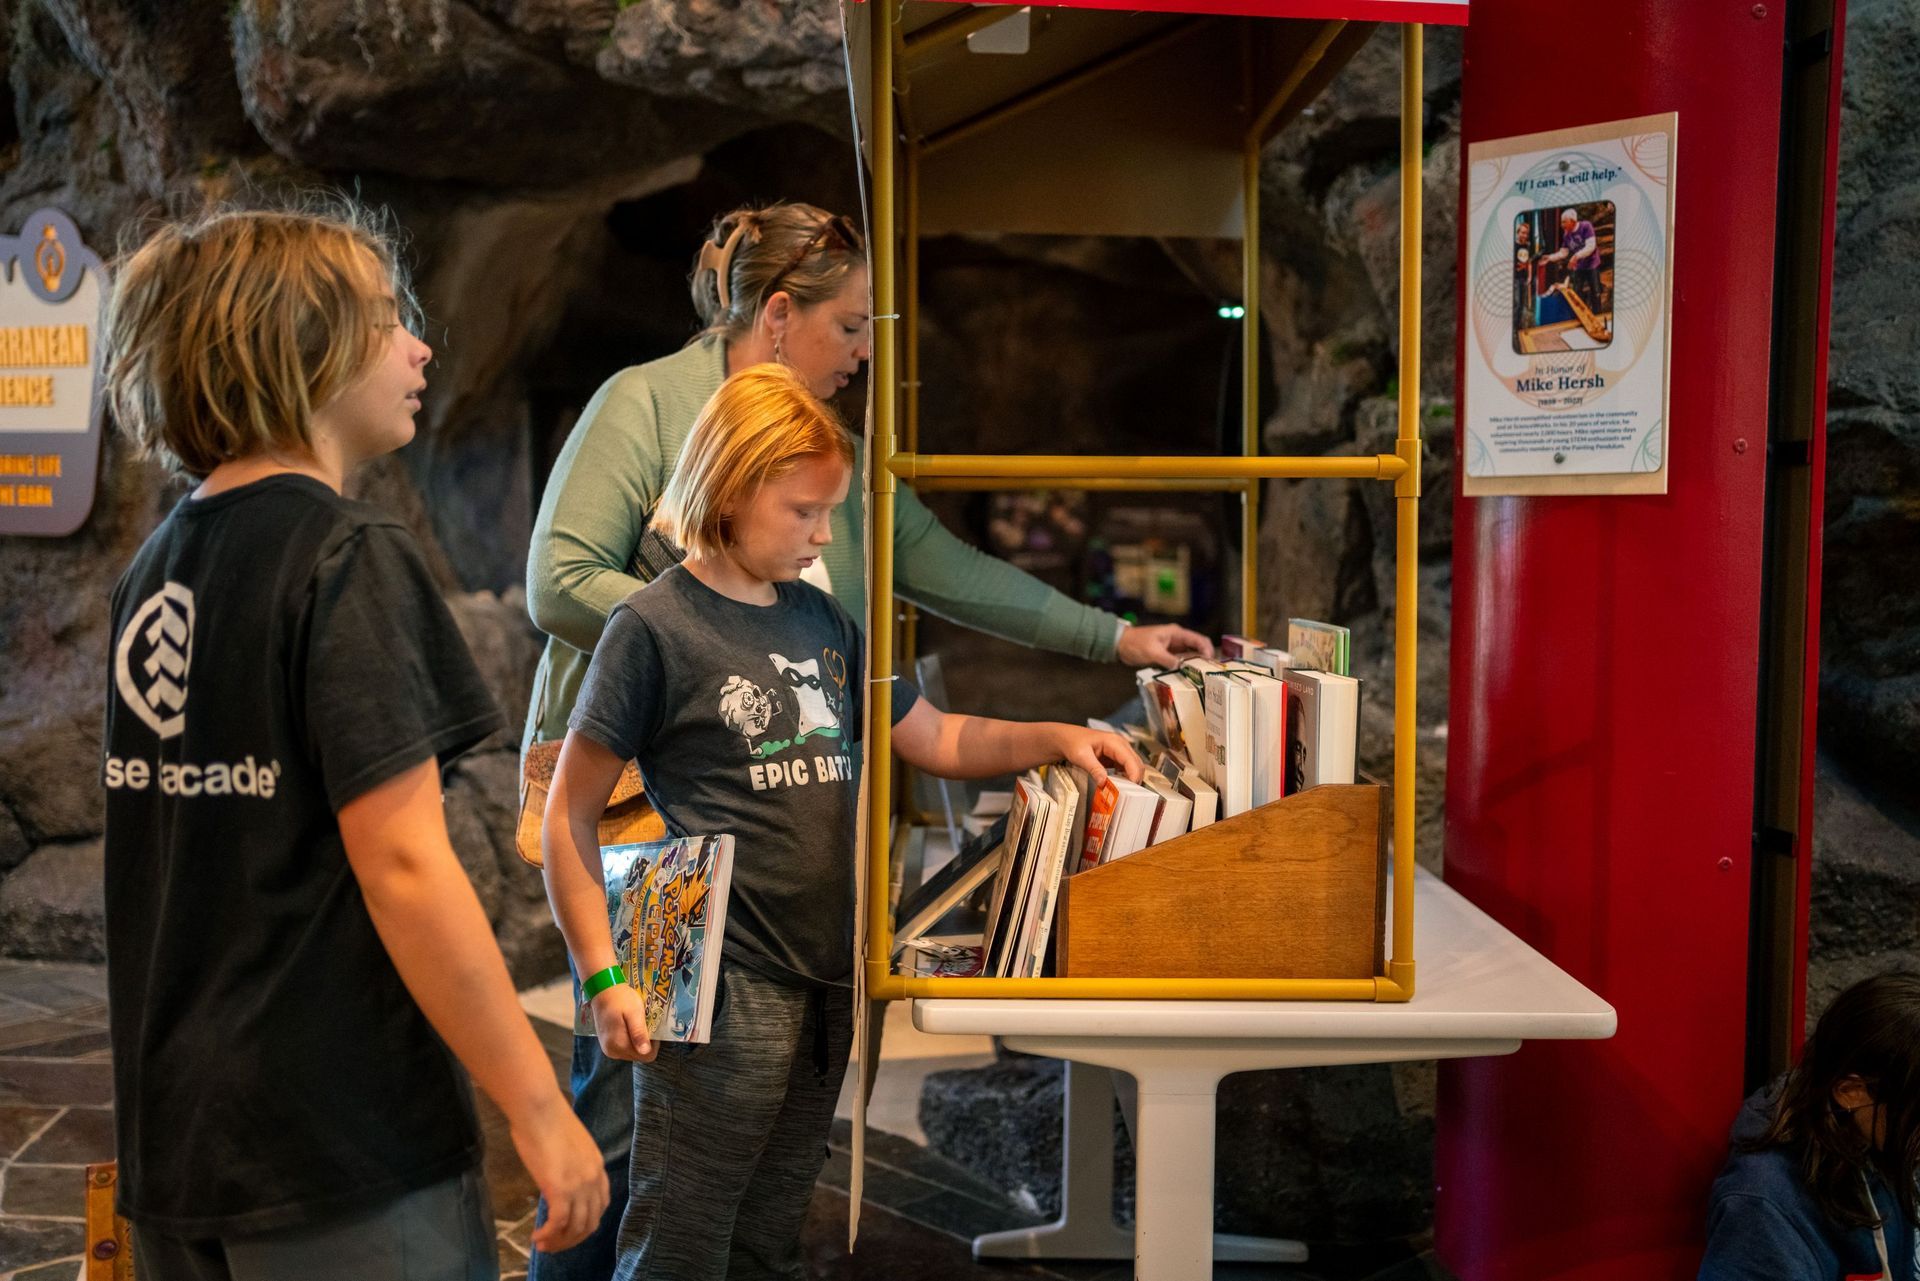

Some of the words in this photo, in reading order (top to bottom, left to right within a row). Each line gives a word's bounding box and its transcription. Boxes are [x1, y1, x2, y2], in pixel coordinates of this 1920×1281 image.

[1569, 171, 1590, 184] will
[1546, 364, 1574, 375] Honor
[1576, 363, 1586, 374] of
[1516, 377, 1553, 393] Mike
[1558, 373, 1605, 390] Hersh
[749, 758, 810, 791] EPIC
[644, 904, 661, 971] EPIC
